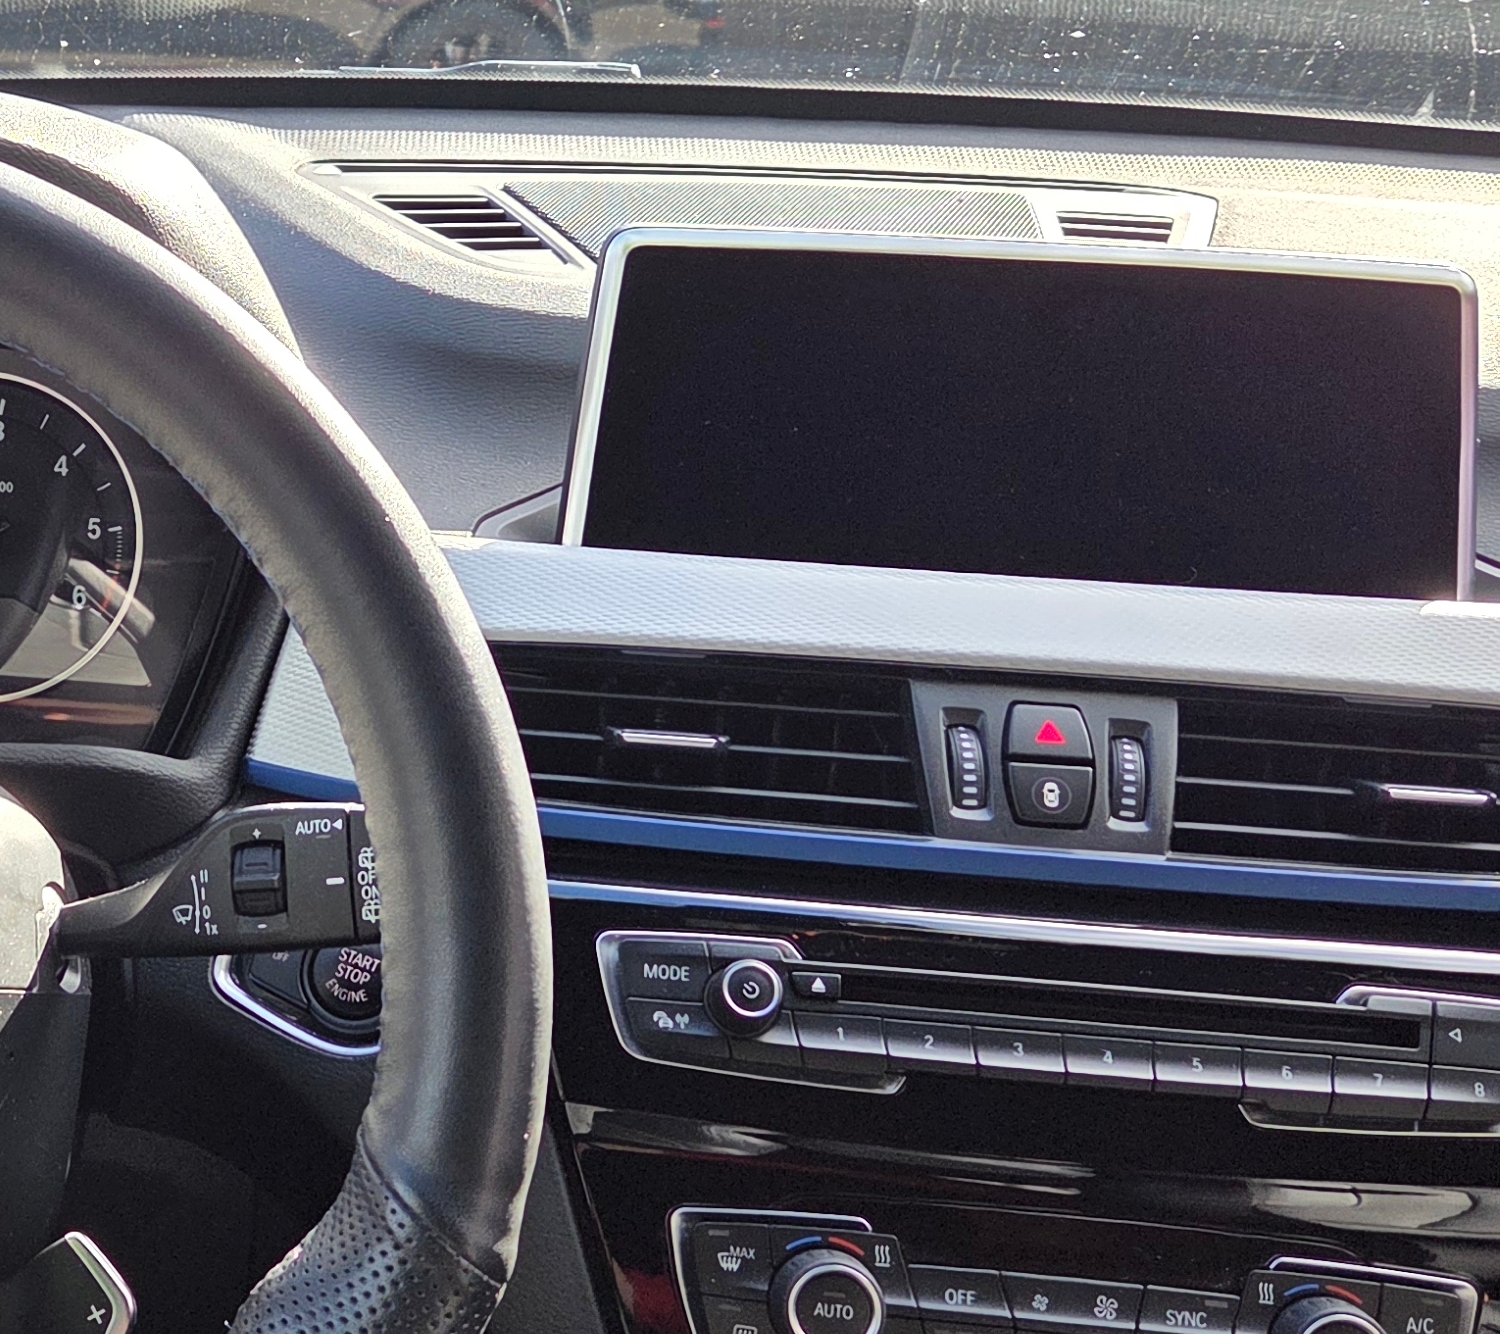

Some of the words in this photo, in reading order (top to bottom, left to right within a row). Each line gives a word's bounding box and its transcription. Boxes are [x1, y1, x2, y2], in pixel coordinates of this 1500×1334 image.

[54, 455, 69, 476] 4
[87, 517, 101, 540] 5
[72, 585, 87, 607] 6
[295, 819, 331, 835] AUTO
[357, 870, 377, 886] OF
[338, 947, 381, 972] START
[335, 963, 371, 985] STOP
[644, 963, 690, 982] MODE
[325, 979, 368, 1003] ENGINE
[837, 1026, 845, 1042] 1
[924, 1035, 934, 1050] 2
[1013, 1042, 1024, 1057] 3
[1102, 1050, 1113, 1065] 4
[1192, 1057, 1203, 1073] 5
[1281, 1065, 1293, 1080] 6
[1373, 1073, 1383, 1087] 7
[1474, 1082, 1485, 1098] 8
[730, 1245, 755, 1260] MAX
[945, 1288, 976, 1306] OFF
[813, 1302, 854, 1320] AUTO
[1166, 1309, 1207, 1328] SYNC
[1406, 1317, 1434, 1334] A/C
